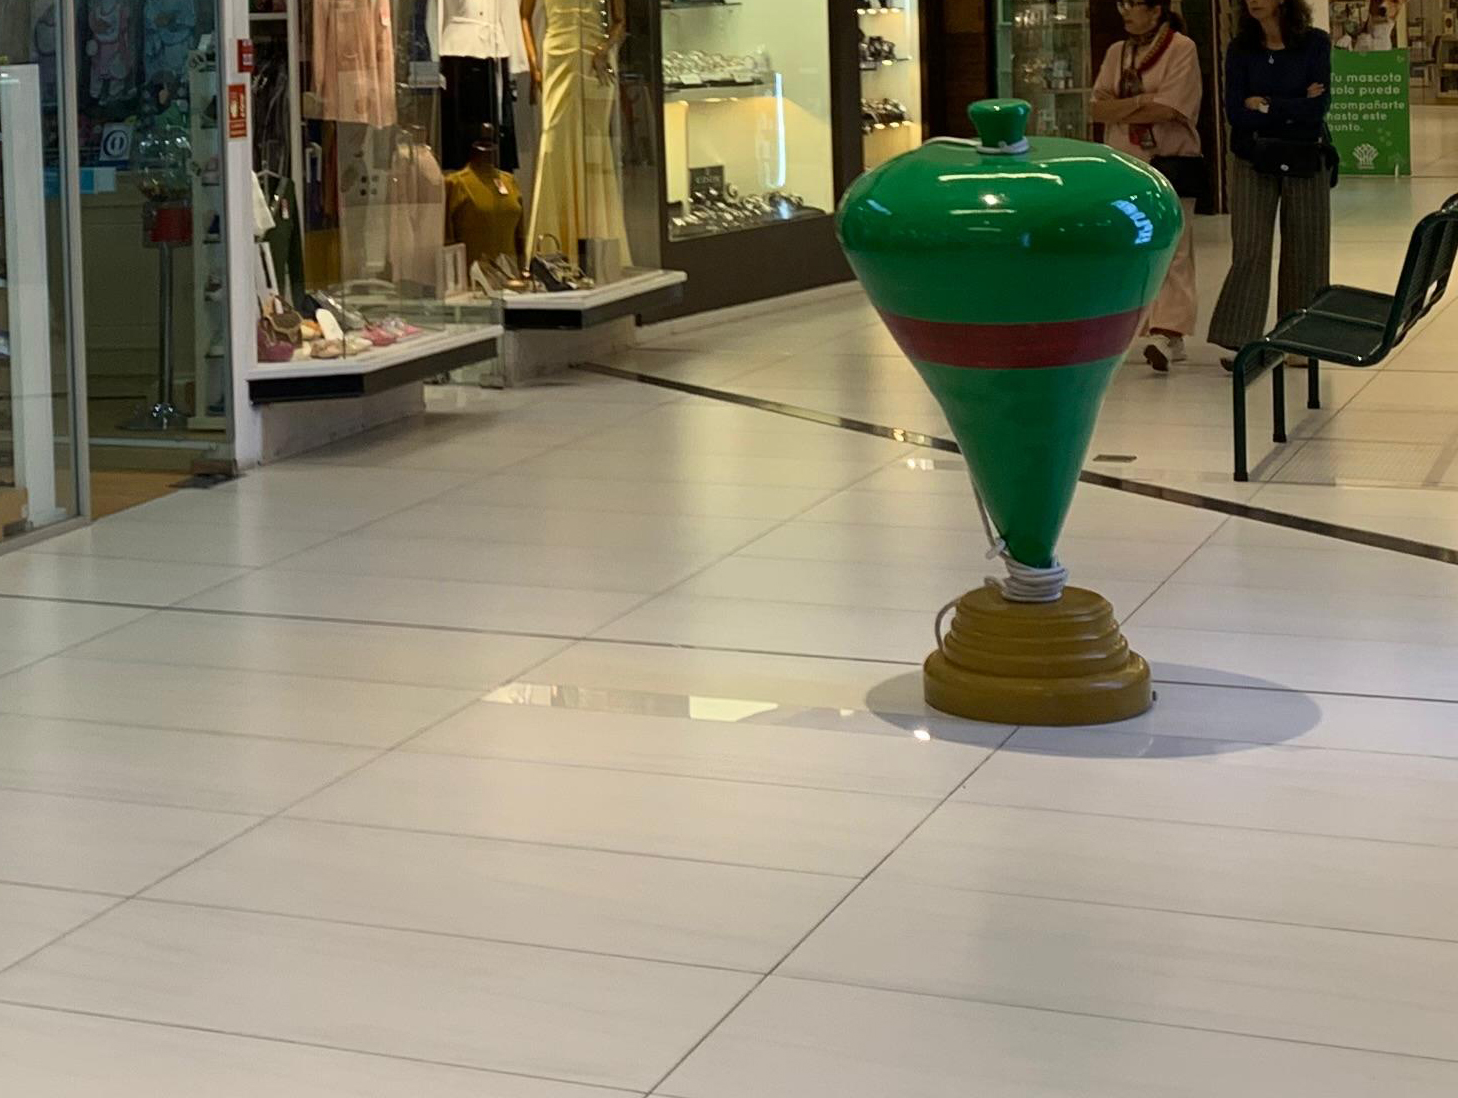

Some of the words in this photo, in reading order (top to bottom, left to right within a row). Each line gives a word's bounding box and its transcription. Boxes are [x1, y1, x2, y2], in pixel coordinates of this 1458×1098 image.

[1346, 72, 1402, 83] mascota
[1330, 84, 1356, 95] solo
[1359, 85, 1401, 97] puede
[1362, 112, 1388, 121] este
